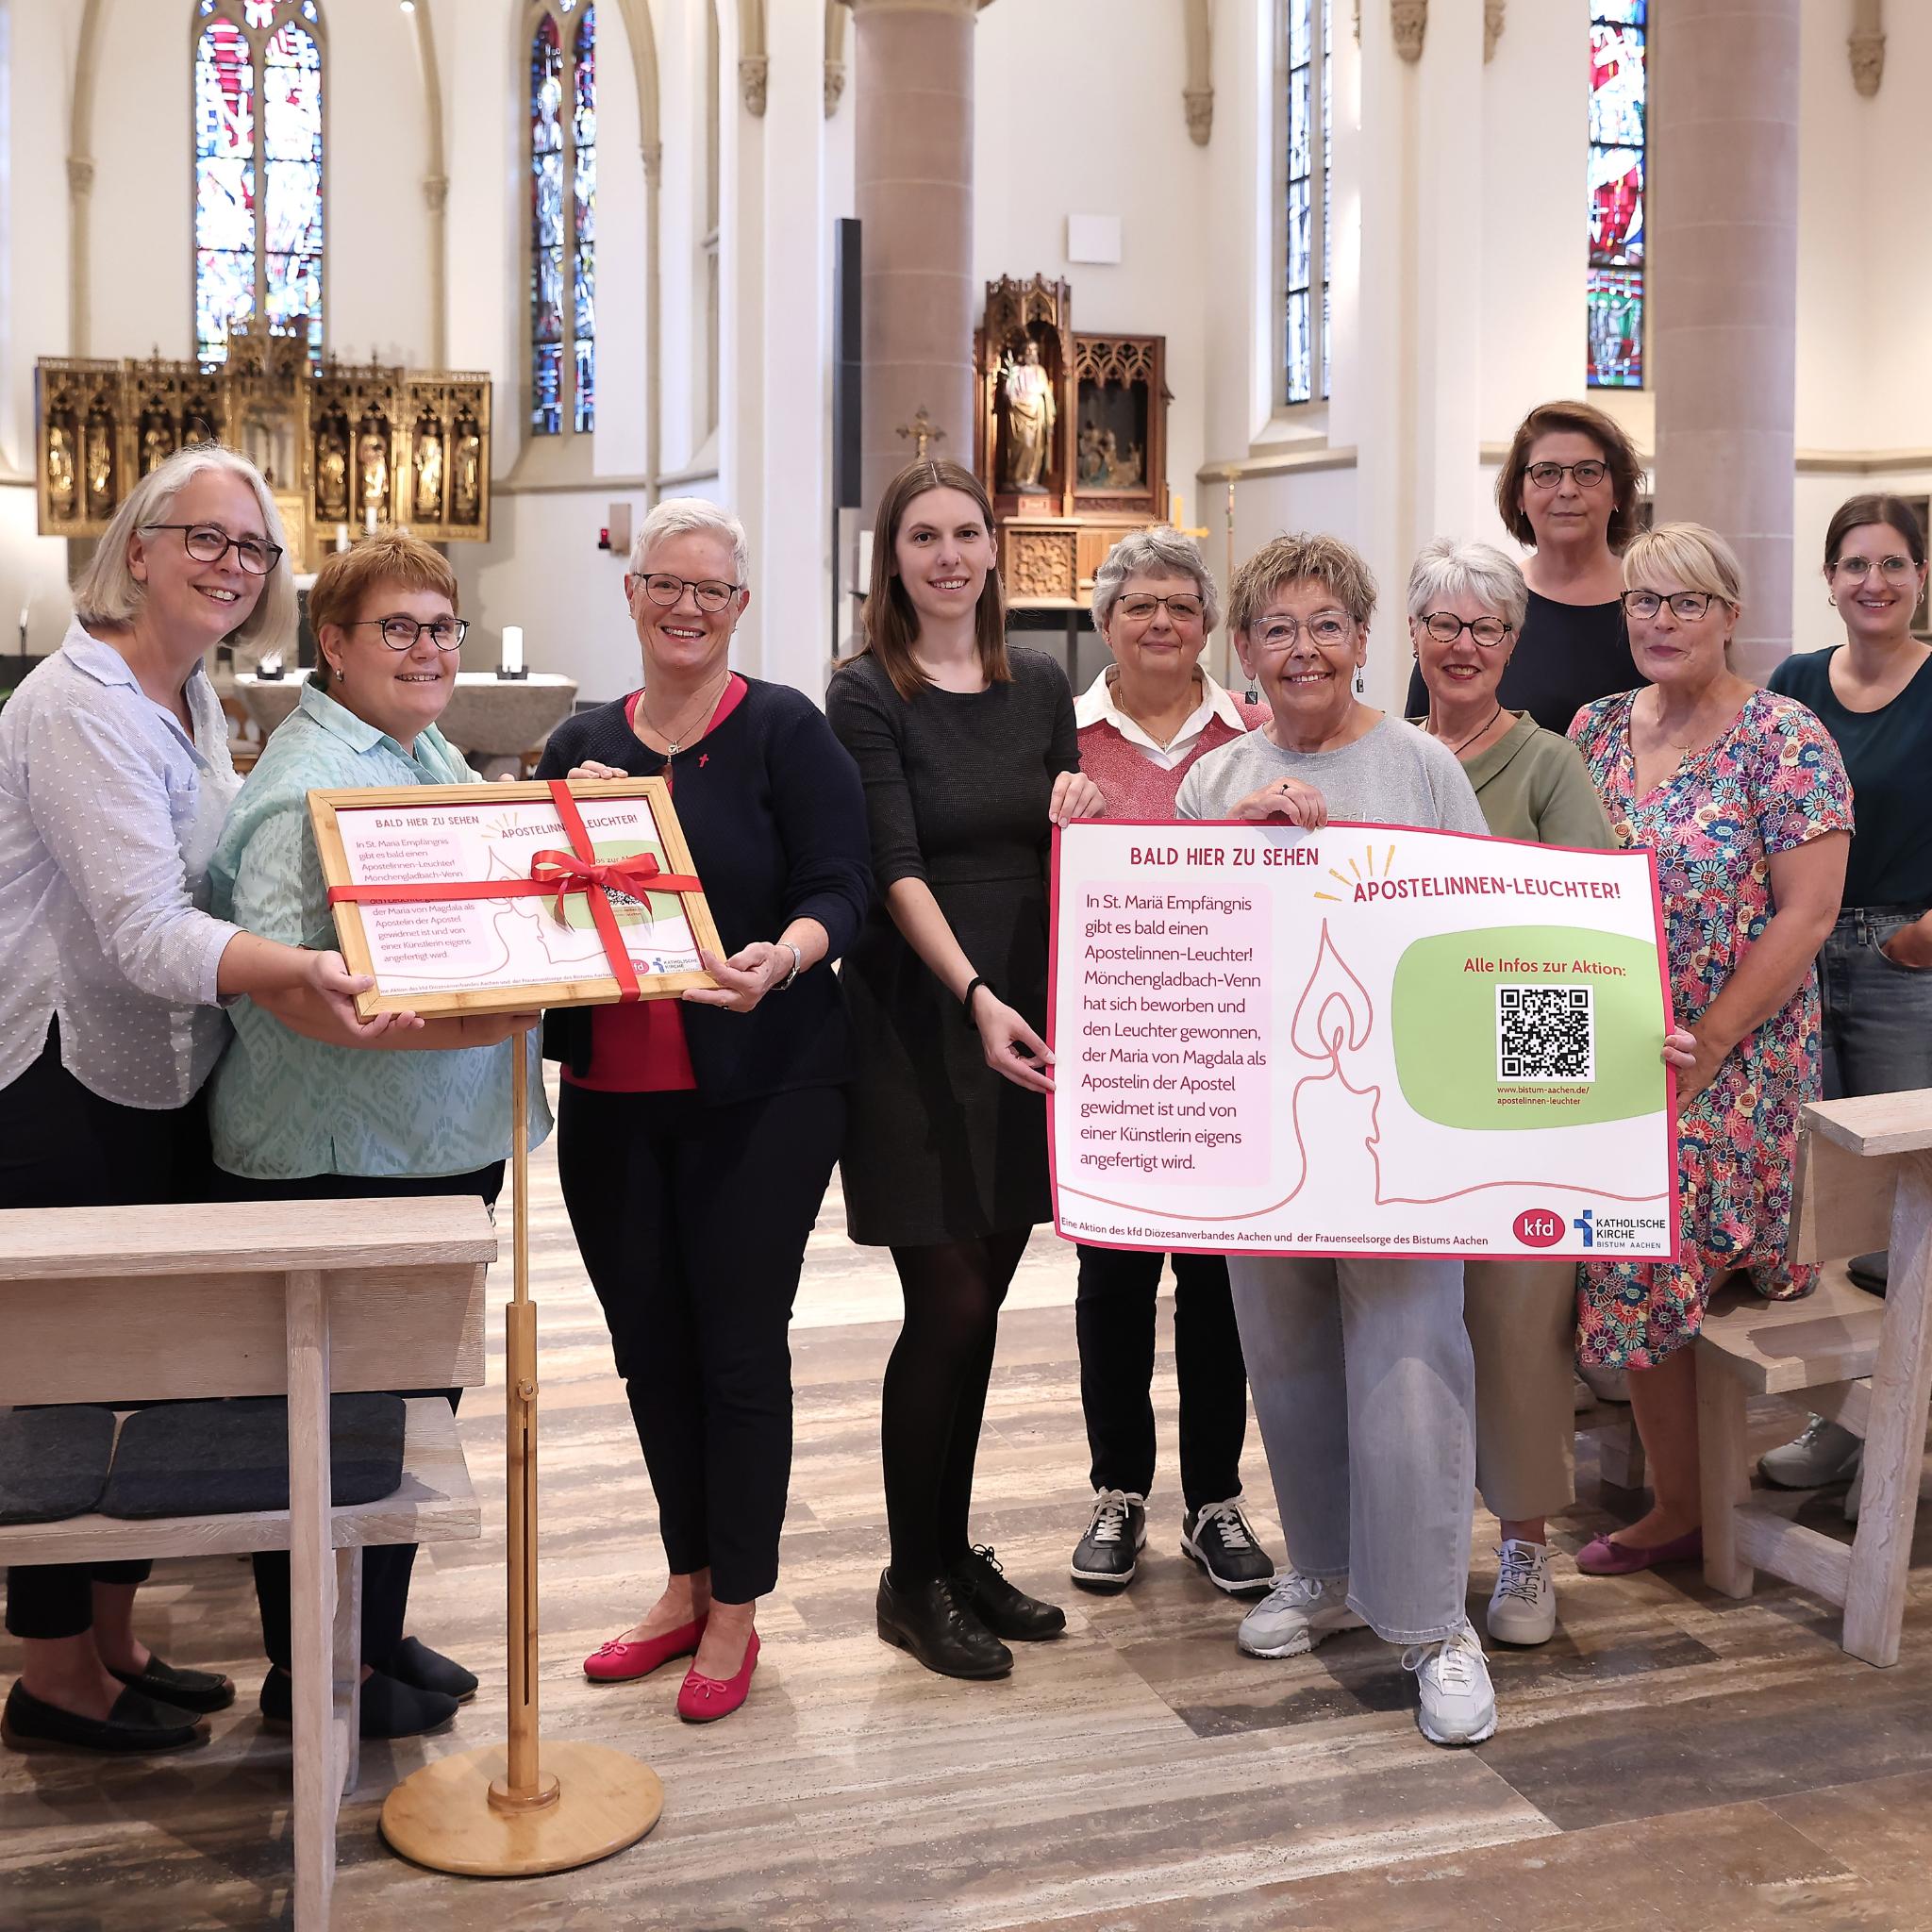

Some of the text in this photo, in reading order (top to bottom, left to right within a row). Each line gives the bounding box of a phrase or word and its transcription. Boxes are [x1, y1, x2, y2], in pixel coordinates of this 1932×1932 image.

[375, 816, 480, 828] BALD HIER ZU SEHEN
[358, 852, 375, 861] gibt
[387, 850, 405, 858] bald
[1130, 847, 1319, 866] BALD HIER ZU SEHEN
[1354, 876, 1621, 903] APOSTELINNEN-LEUCHTER!
[428, 904, 462, 914] Magdala
[1086, 894, 1252, 914] In St. Mariä Empfängnis
[375, 915, 461, 928] Apostelin der Apostel
[1085, 920, 1208, 938] gibt es bald einen
[377, 930, 420, 941] gewidmet
[444, 939, 472, 948] eigens
[1084, 945, 1253, 963] Apostelinnen-Leuchter!
[1463, 958, 1626, 976] Alle Infos zur Aktion:
[1084, 971, 1261, 990] Mönchengladbach-Venn
[1083, 995, 1245, 1013] hat sich beworben und
[1083, 1022, 1261, 1041] den Leuchter gewonnen,
[1082, 1047, 1266, 1069] der Maria von Magdala als
[1081, 1074, 1235, 1094] Apostelin der Apostel
[1497, 1086, 1590, 1094] www.bistum-aachen.de/
[1080, 1100, 1237, 1118] gewidmet ist und von
[1497, 1097, 1581, 1106] apostelinnen-leuchter
[1080, 1126, 1242, 1147] einer Künstlerin eigens
[1080, 1152, 1195, 1172] angefertigt wird.
[1061, 1217, 1489, 1247] Eine Aktion des kfd Diözesanverbandes Aachen und der Frauenseelsorge des Bistums Aachen
[1524, 1218, 1554, 1237] kfd
[1596, 1219, 1666, 1229] KATHOLISCHE
[1596, 1229, 1635, 1239] KIRCHE
